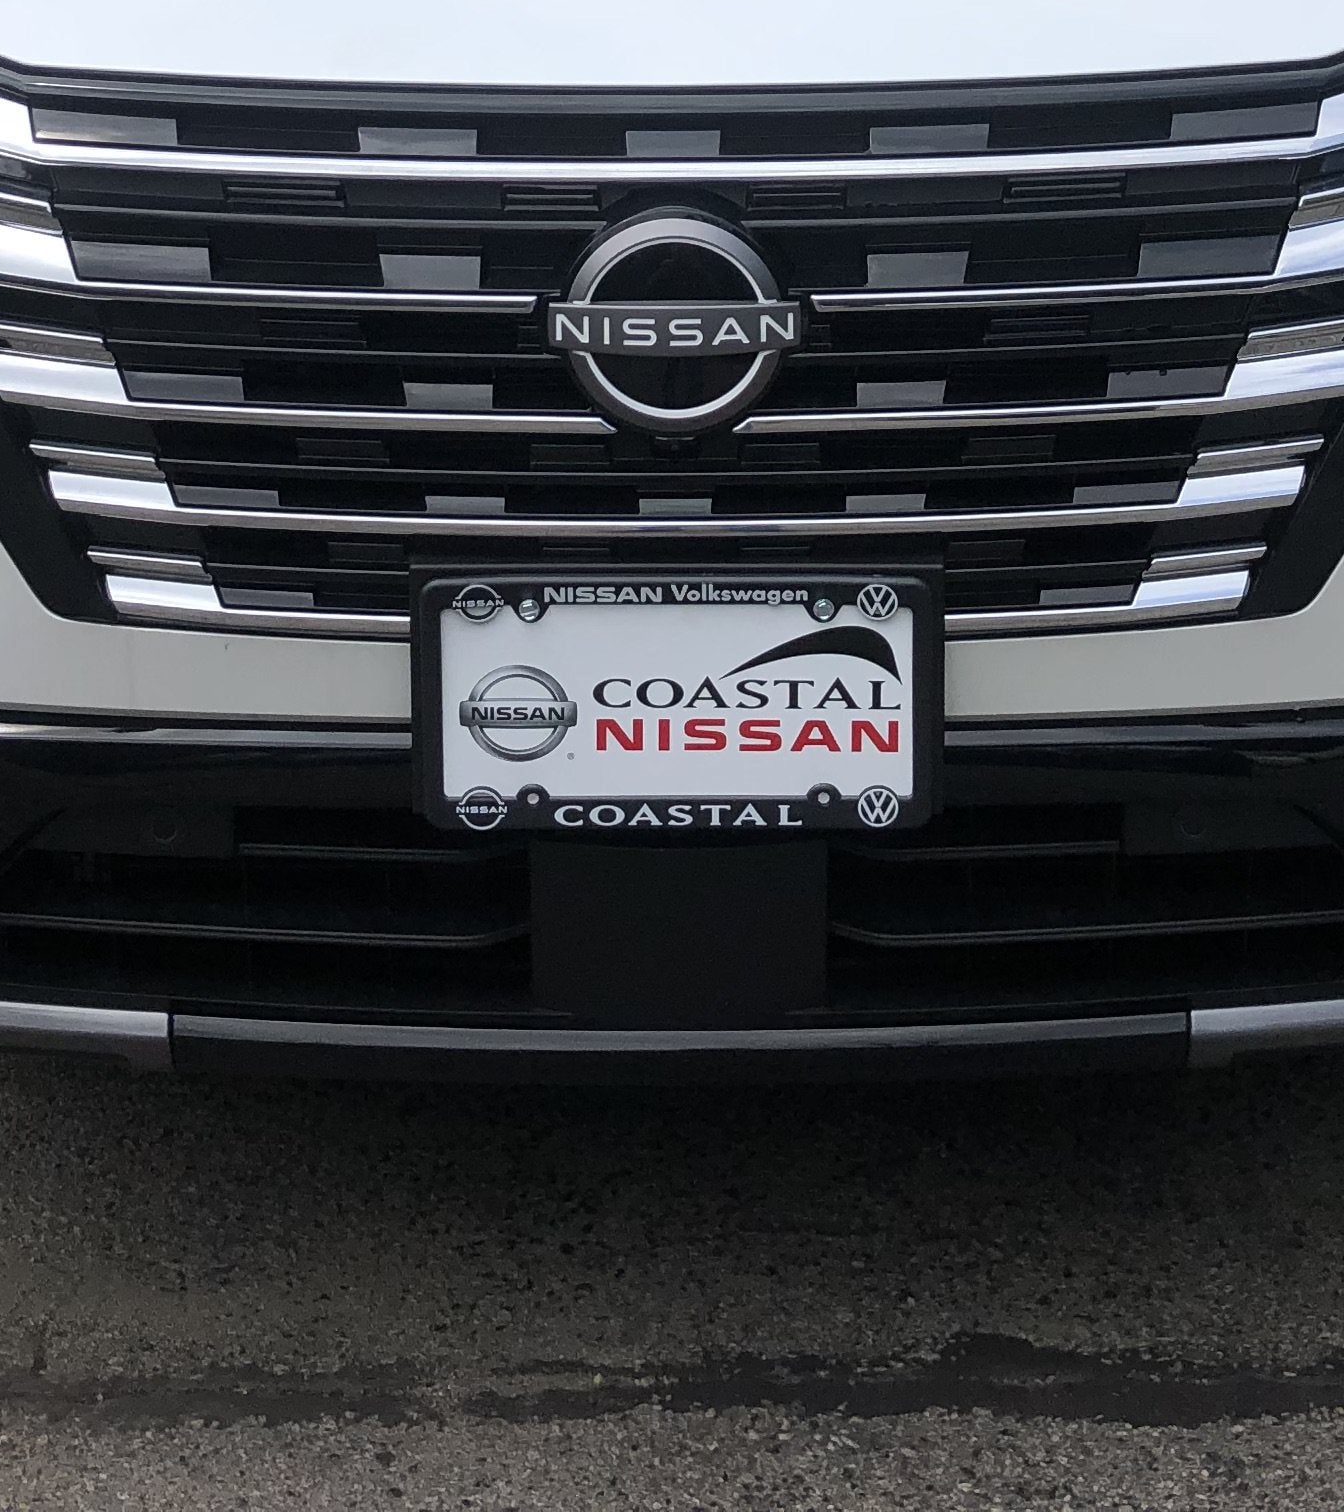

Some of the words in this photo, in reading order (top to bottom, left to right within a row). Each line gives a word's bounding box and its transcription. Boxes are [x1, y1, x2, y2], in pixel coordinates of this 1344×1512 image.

[555, 312, 795, 347] NISSAN
[452, 599, 504, 608] NISSAN
[543, 586, 663, 603] NISSAN
[670, 584, 809, 604] Volkswagen
[592, 676, 902, 711] COASTAL
[470, 705, 566, 722] NISSAN
[595, 718, 900, 753] NISSAN
[455, 805, 508, 814] NISSAN
[553, 803, 804, 827] COASTAL
